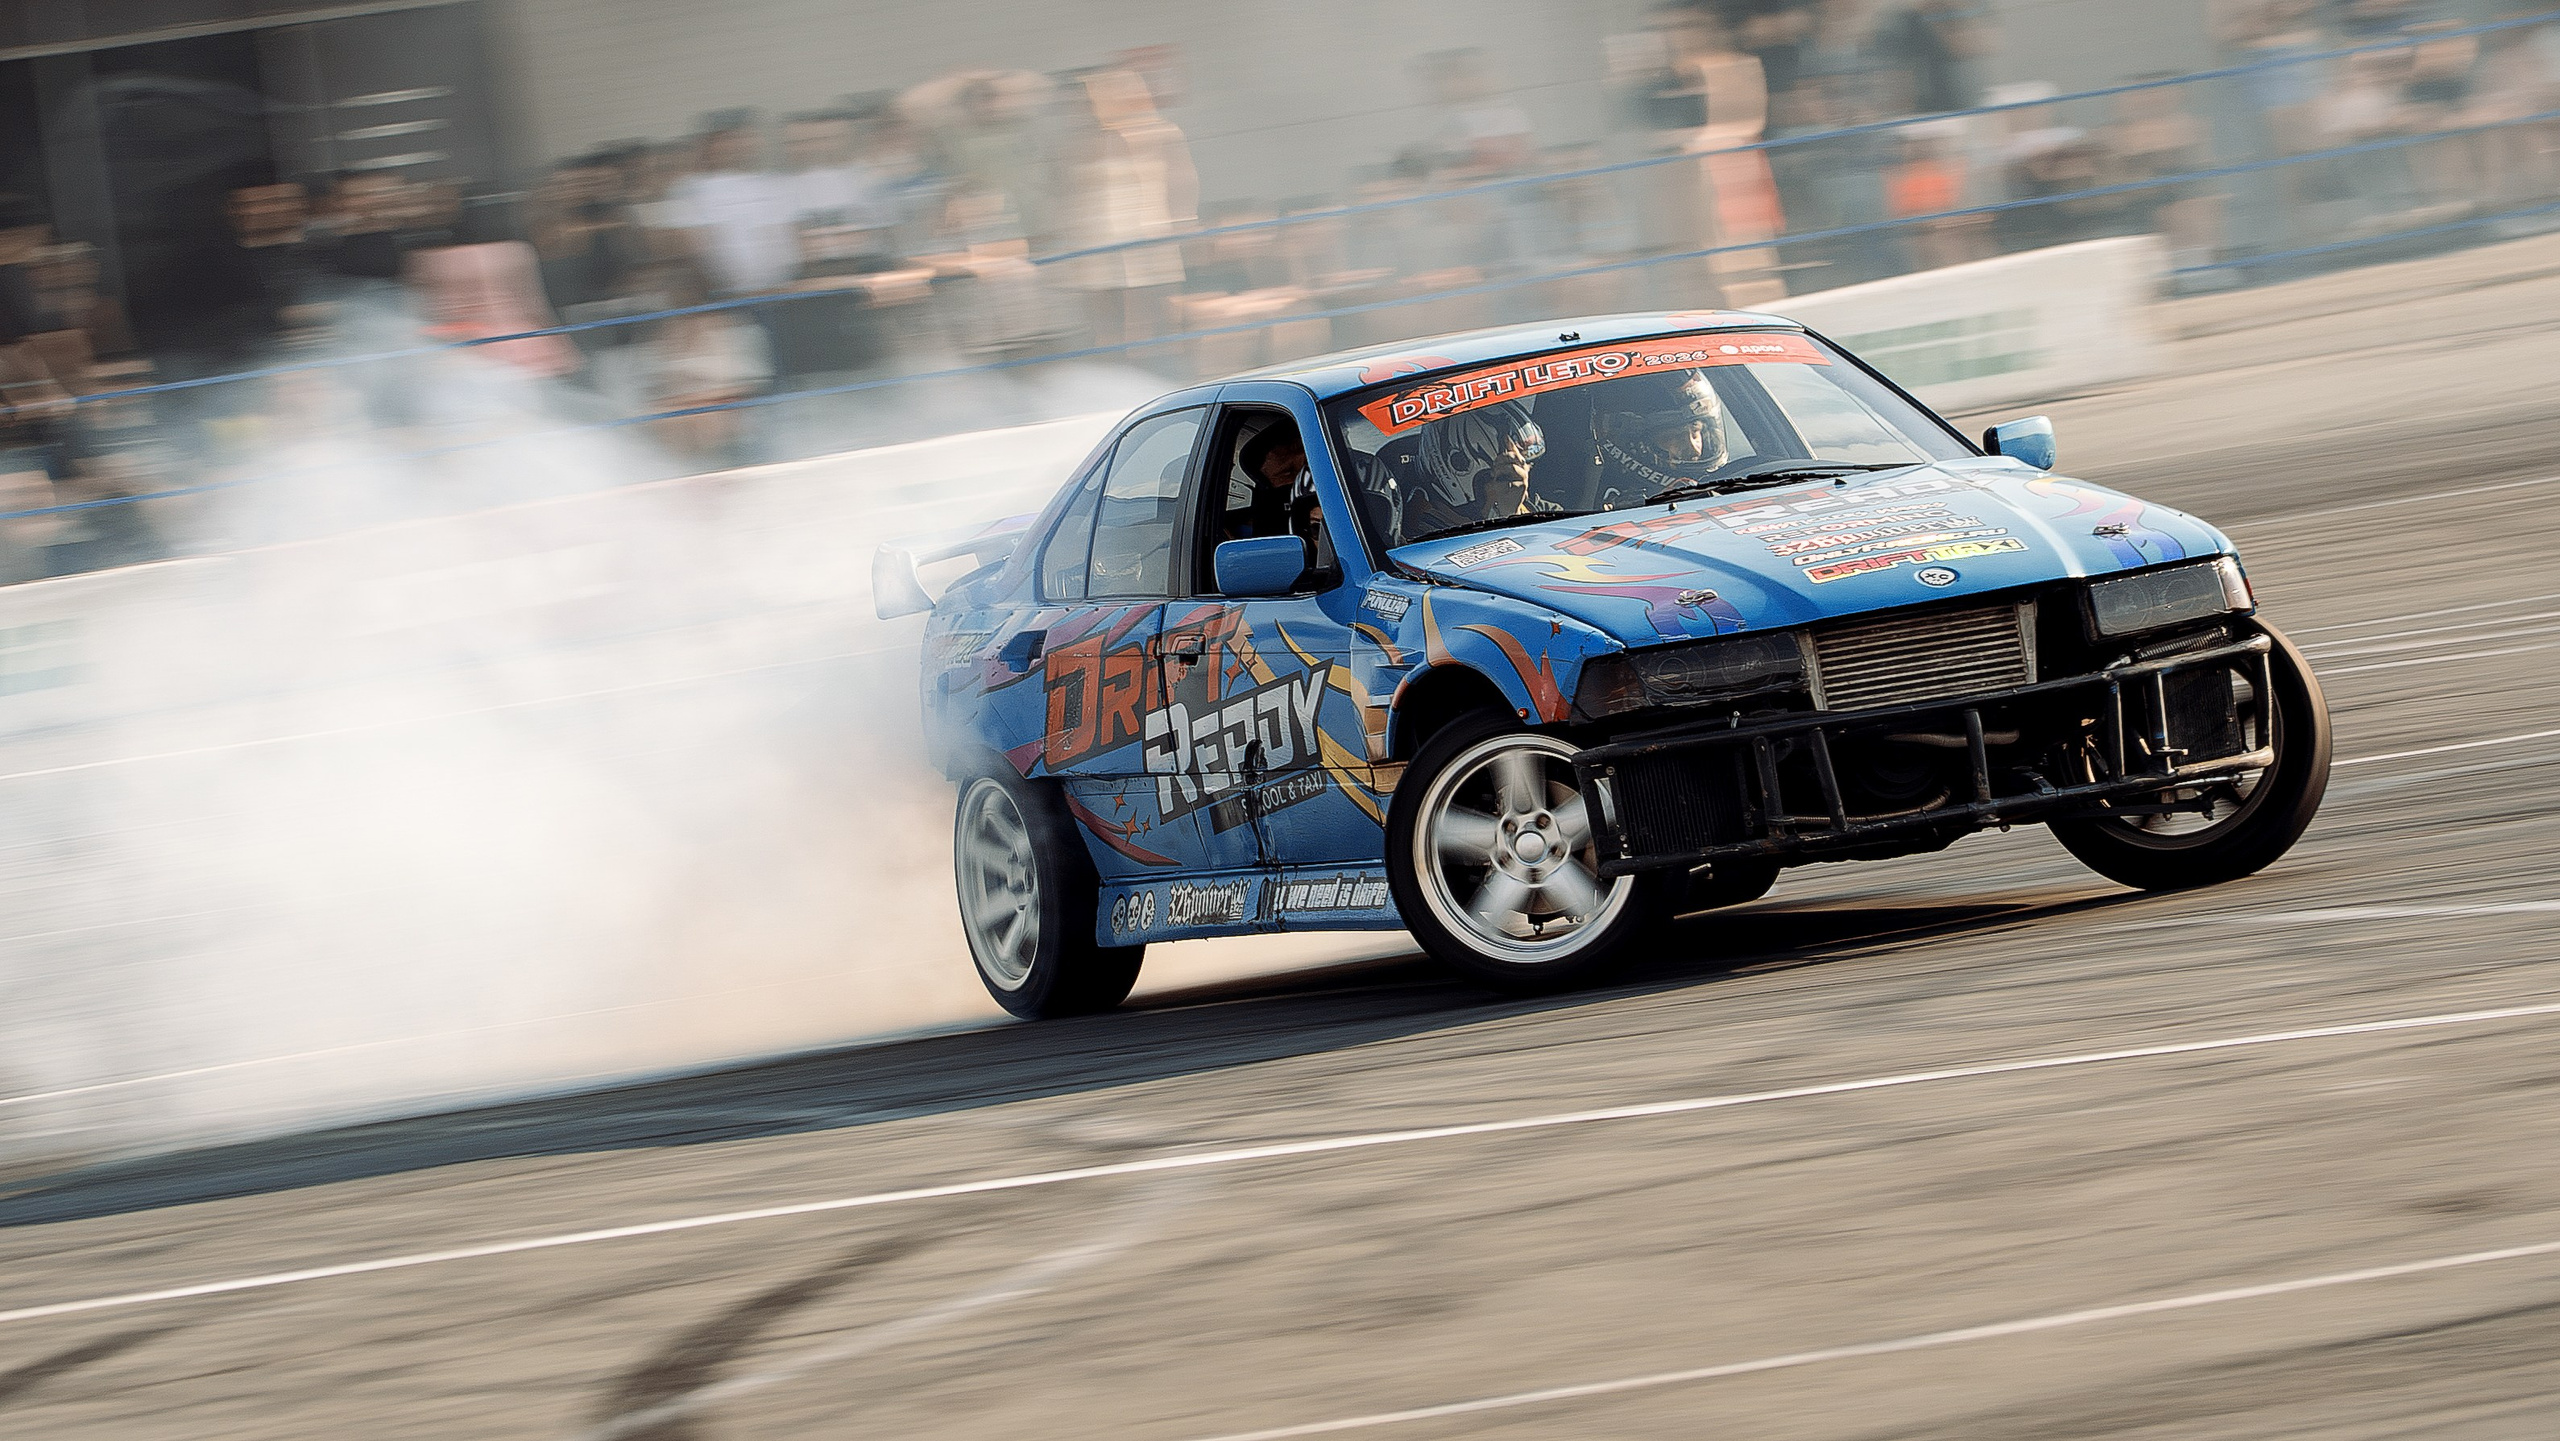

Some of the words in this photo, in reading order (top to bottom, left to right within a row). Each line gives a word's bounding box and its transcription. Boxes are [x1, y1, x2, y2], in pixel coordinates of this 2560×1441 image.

[1393, 372, 1518, 425] DRIFT
[1526, 352, 1630, 386] LETO
[1644, 351, 1708, 366] 2026
[1757, 508, 1953, 542] REFORMING
[1045, 608, 1242, 766] DRIFT
[1287, 781, 1297, 800] &
[1298, 770, 1324, 796] TAXI
[1286, 885, 1309, 909] we
[1306, 877, 1341, 908] need
[1337, 883, 1353, 907] is
